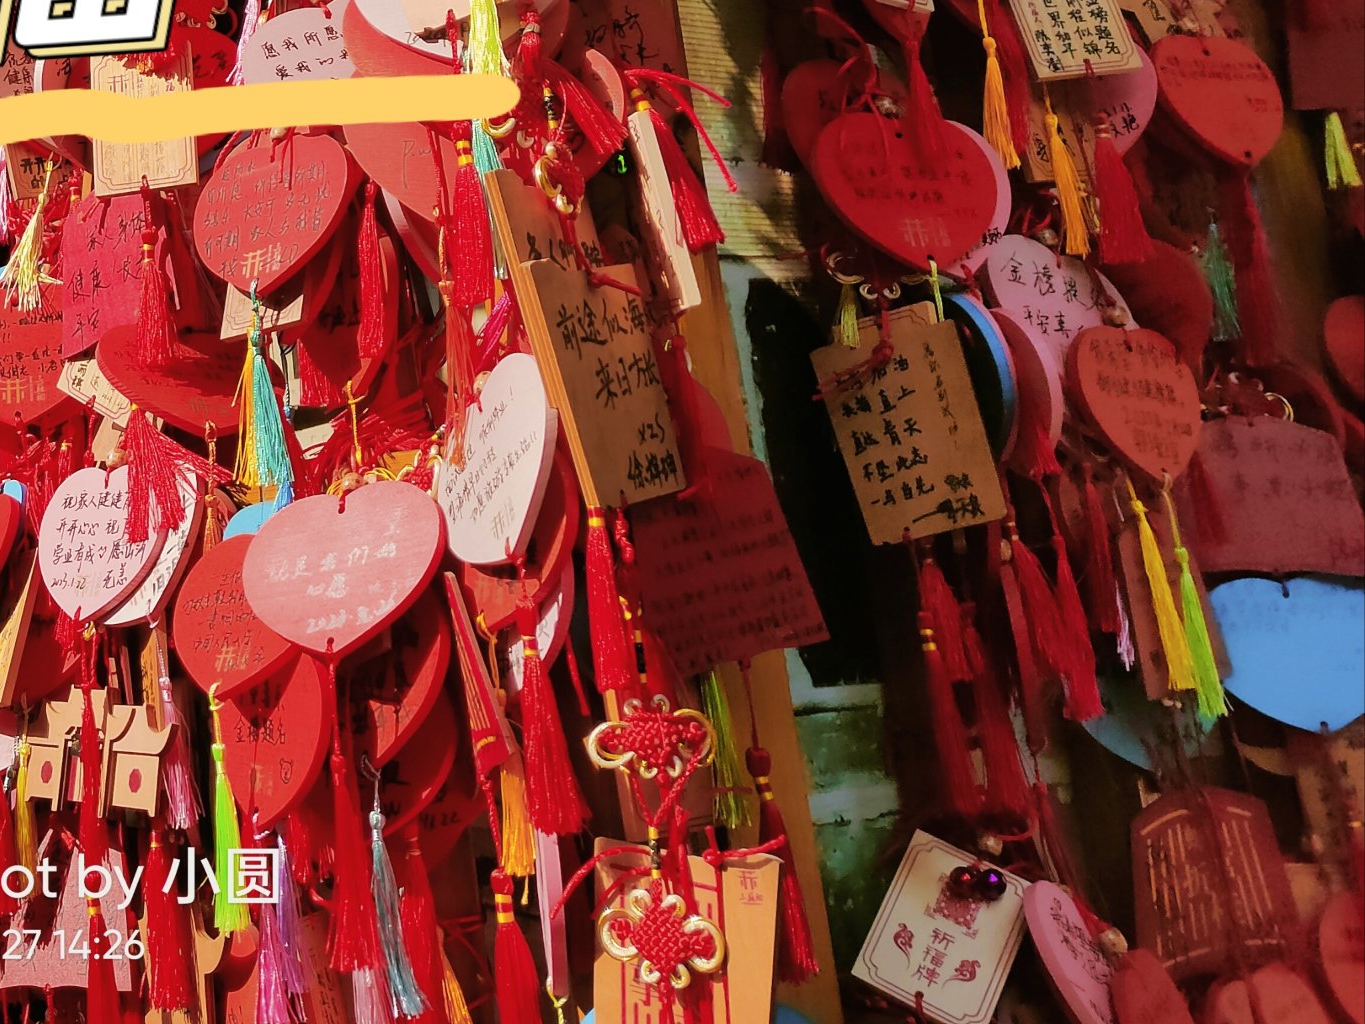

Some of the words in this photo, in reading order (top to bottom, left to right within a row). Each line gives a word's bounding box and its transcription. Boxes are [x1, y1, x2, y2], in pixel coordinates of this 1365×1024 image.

[556, 291, 646, 360] 前途似海
[913, 926, 956, 988] 祈福牌
